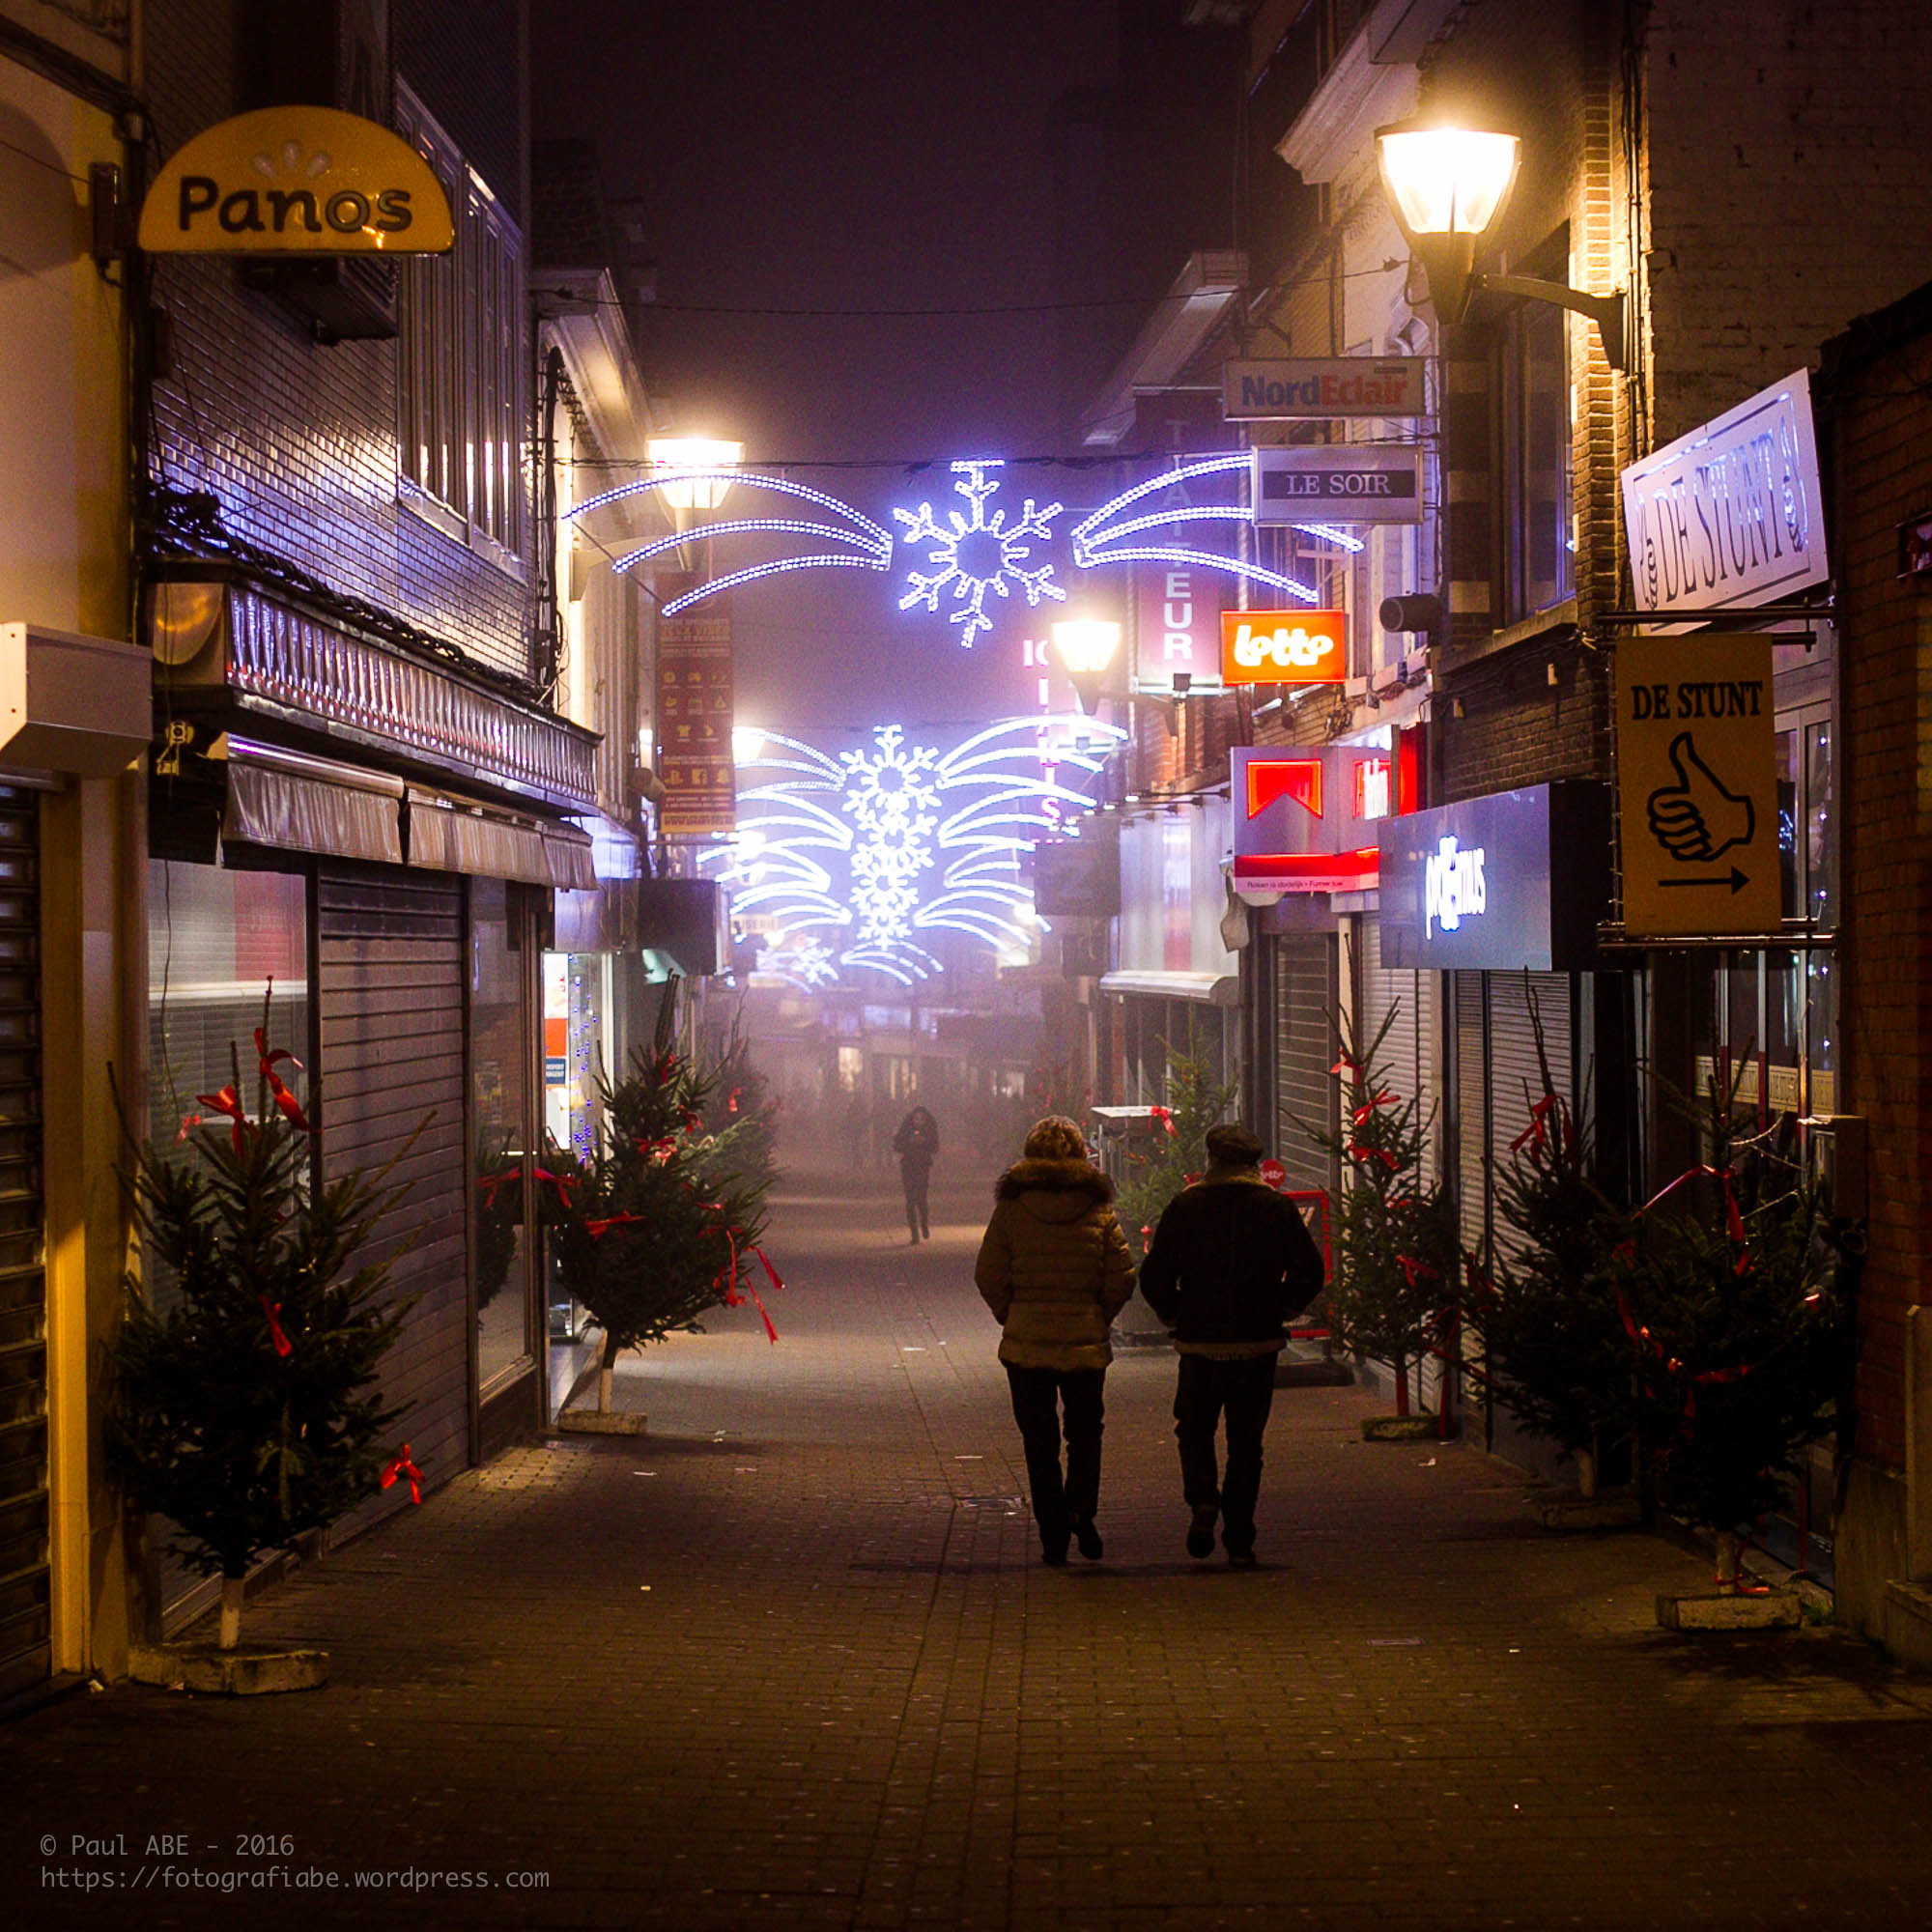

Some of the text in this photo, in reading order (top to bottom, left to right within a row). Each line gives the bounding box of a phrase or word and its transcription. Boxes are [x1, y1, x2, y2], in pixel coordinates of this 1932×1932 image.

[179, 177, 412, 233] Panos
[1287, 474, 1391, 495] LE SOIR
[1653, 429, 1782, 602] DE STUNT
[1632, 681, 1763, 720] DE STUNT
